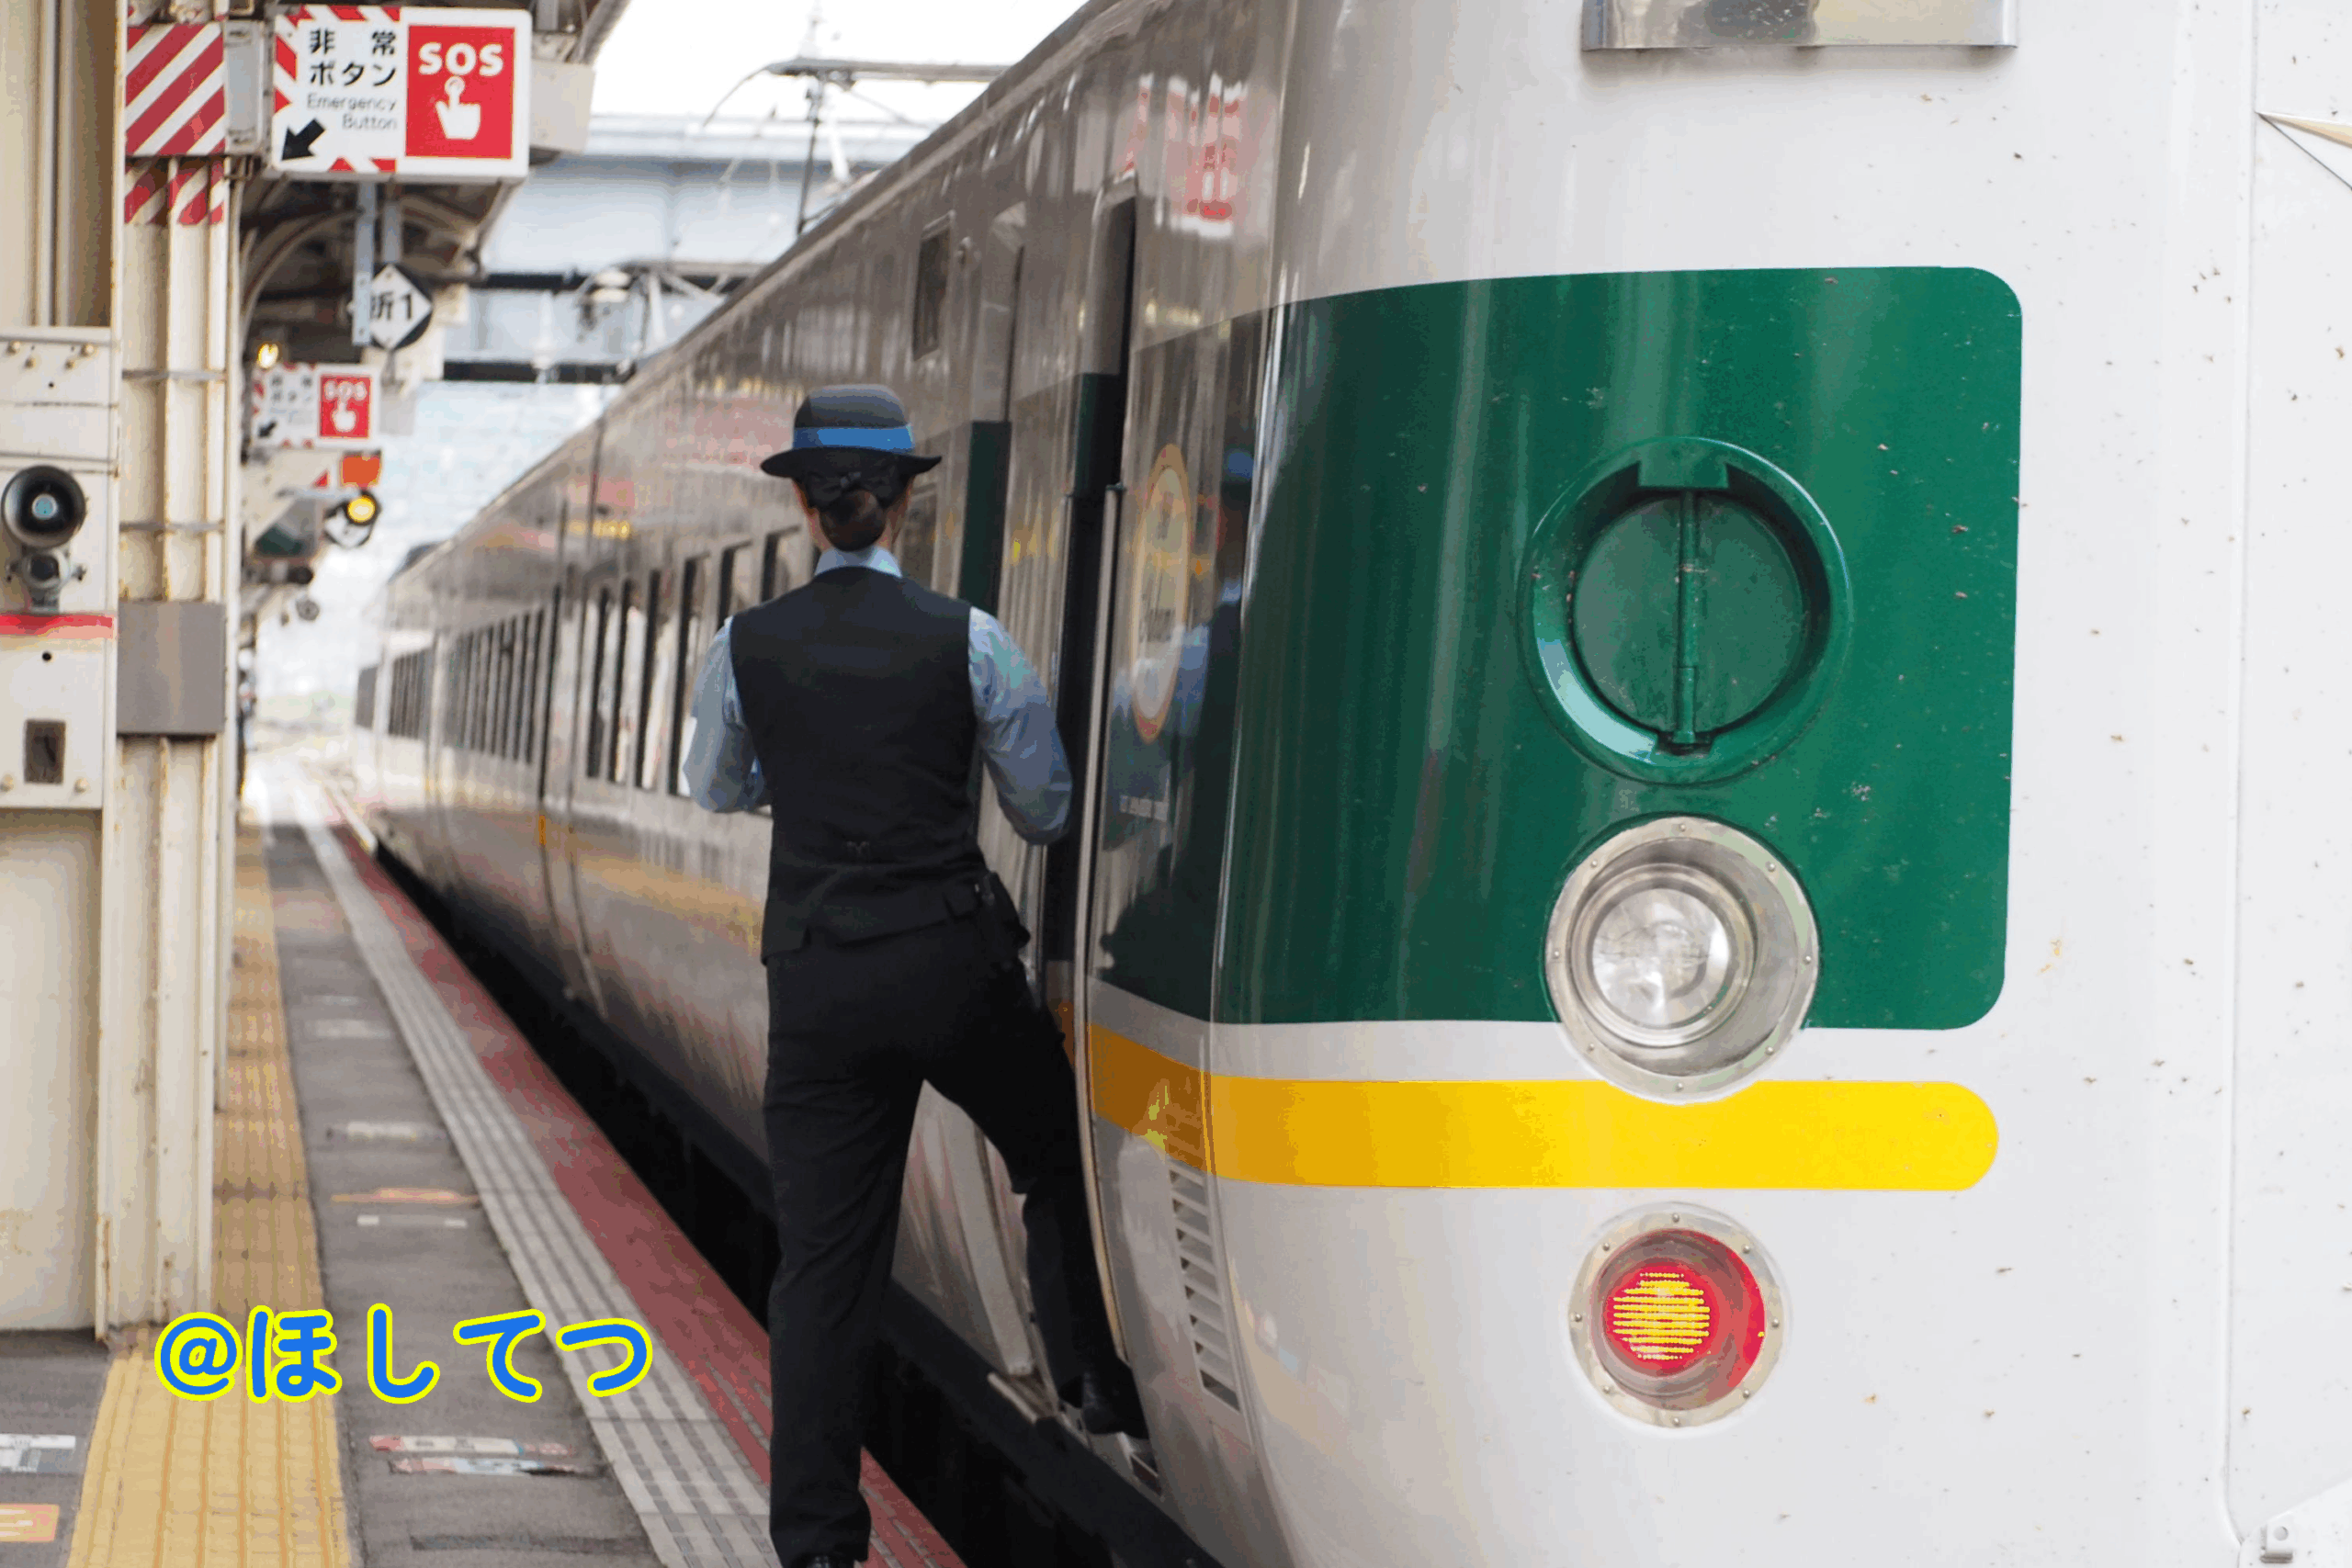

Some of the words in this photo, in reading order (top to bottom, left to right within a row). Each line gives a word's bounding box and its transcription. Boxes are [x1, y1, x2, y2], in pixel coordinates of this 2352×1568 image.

[311, 28, 396, 55] 非常
[418, 41, 504, 76] SOS
[311, 61, 396, 86] ボタン
[307, 92, 397, 111] Emergency
[342, 113, 397, 130] Button
